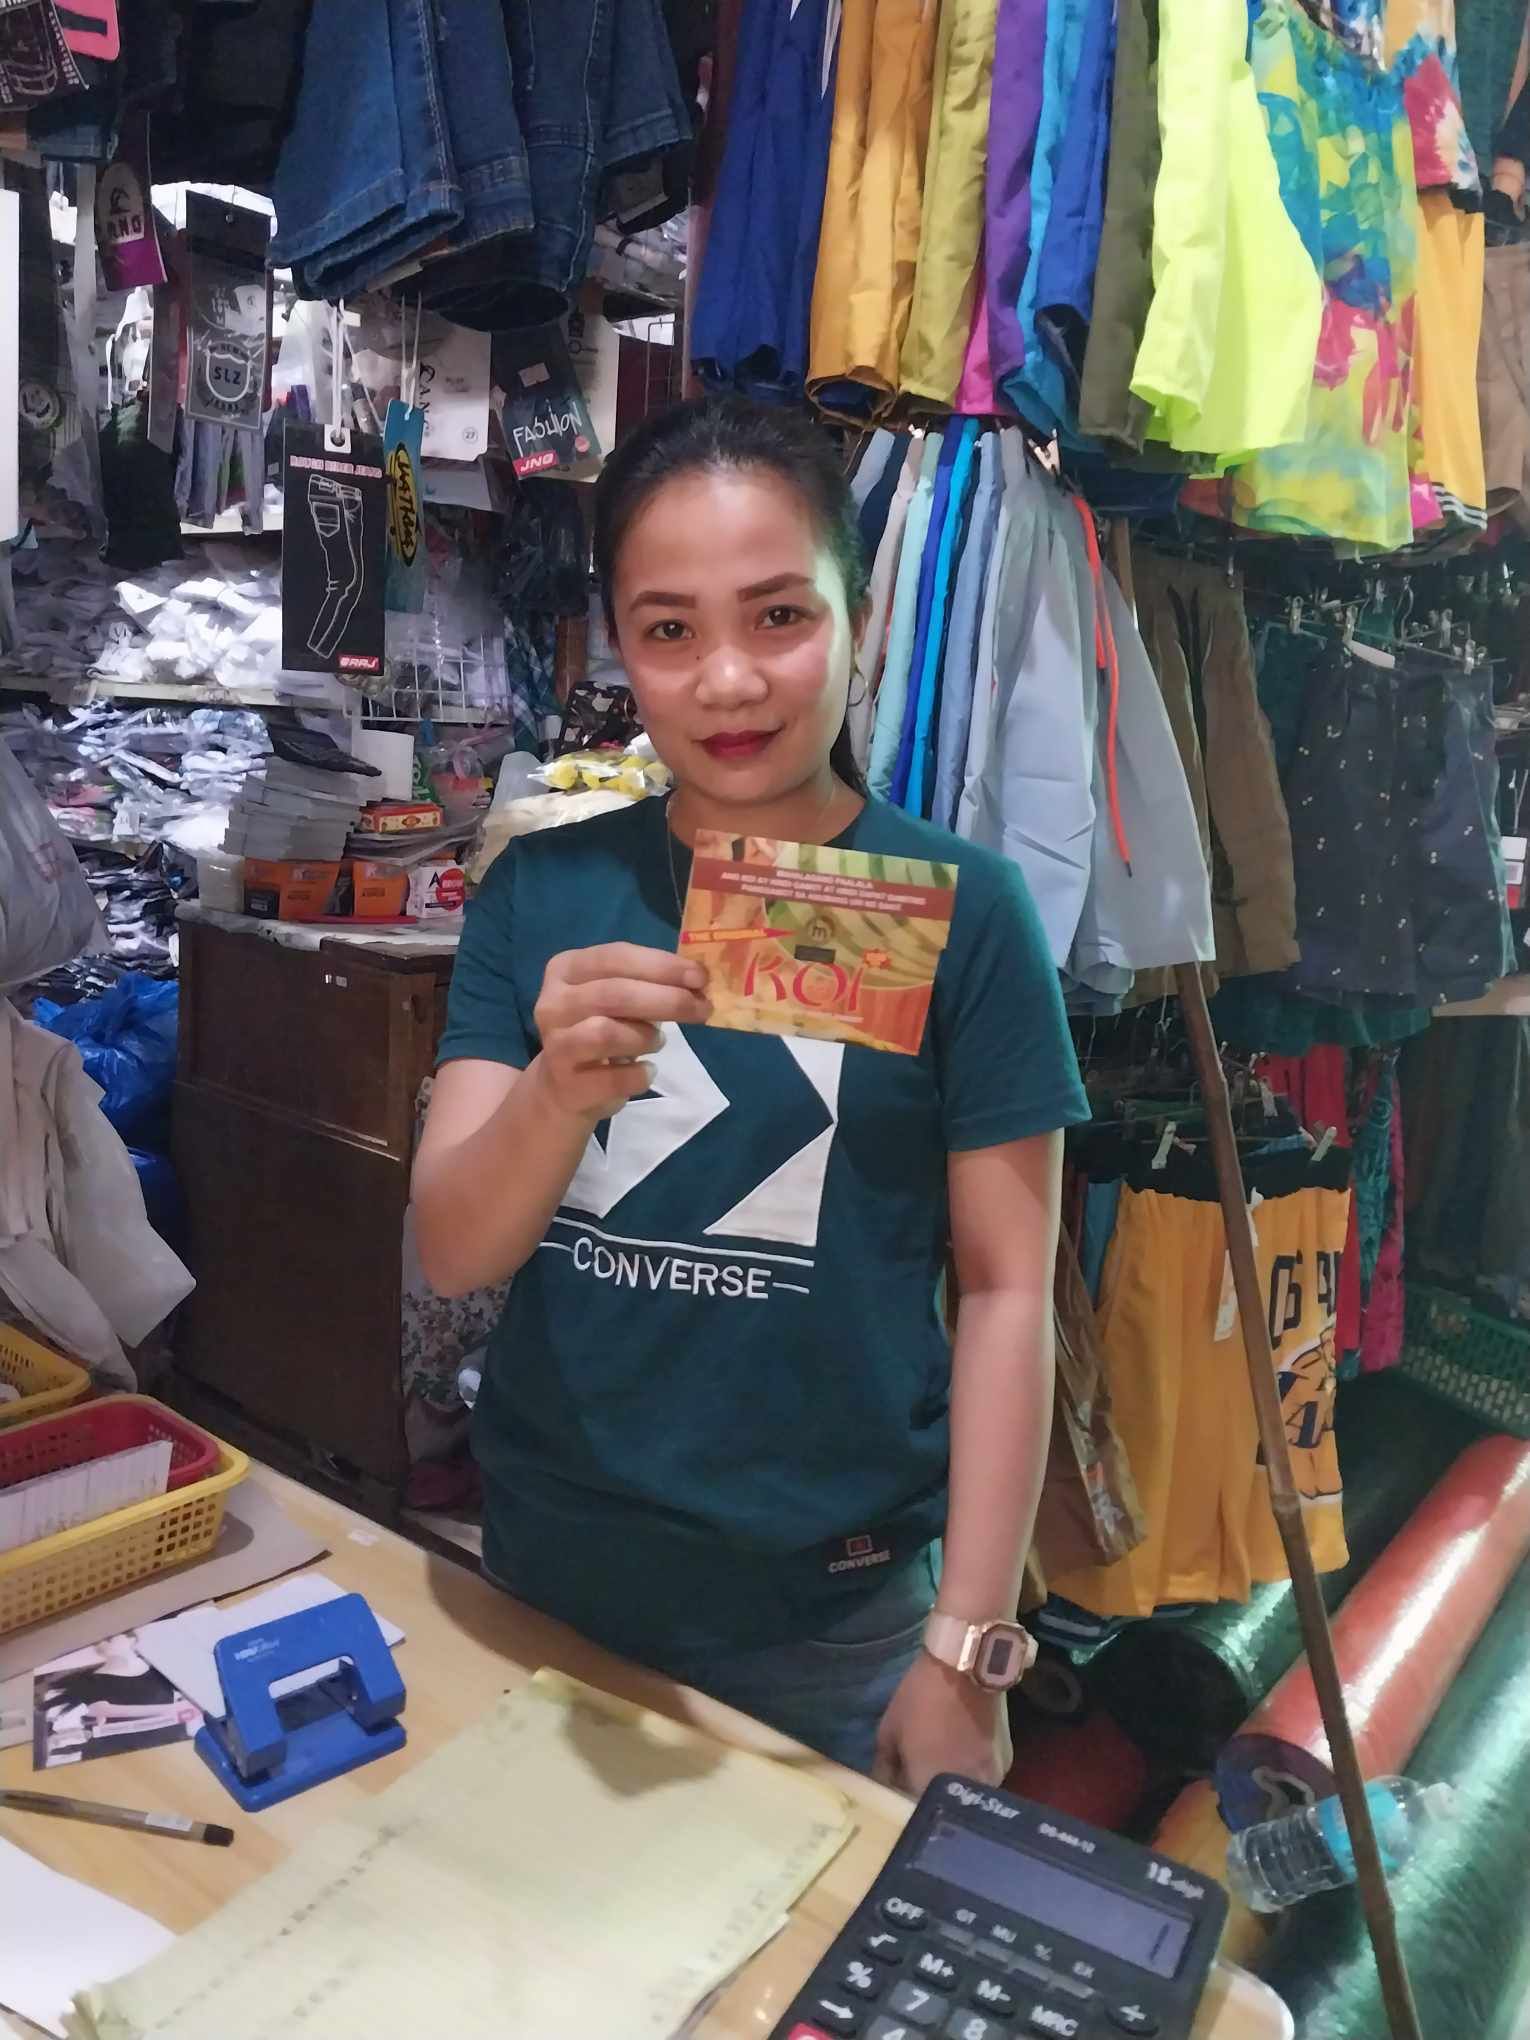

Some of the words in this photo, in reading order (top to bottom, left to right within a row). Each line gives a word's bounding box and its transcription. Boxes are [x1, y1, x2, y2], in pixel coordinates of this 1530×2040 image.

[573, 1237, 772, 1299] CONVERSE
[828, 1549, 890, 1574] CONVERSE
[885, 1897, 925, 1920] OFF
[906, 1988, 930, 2011] 7
